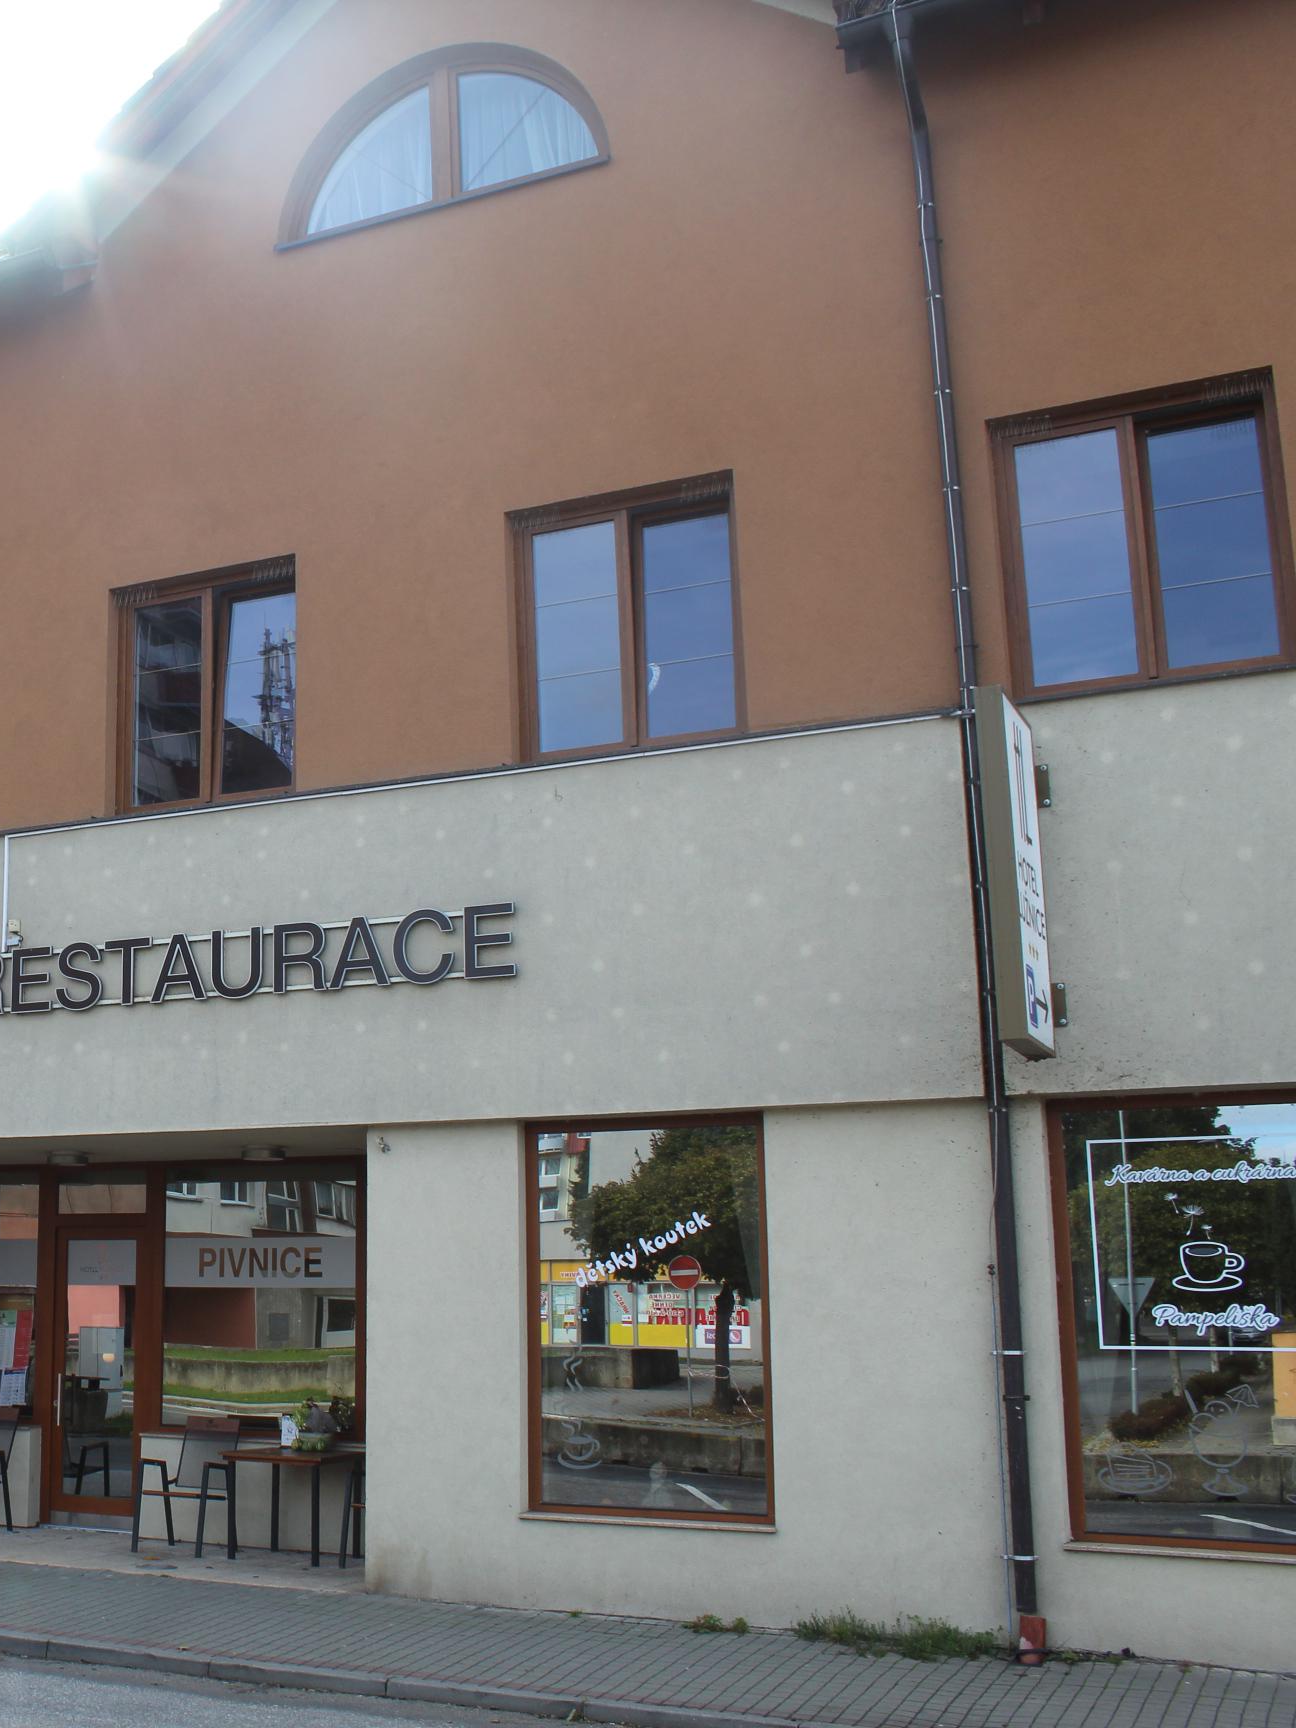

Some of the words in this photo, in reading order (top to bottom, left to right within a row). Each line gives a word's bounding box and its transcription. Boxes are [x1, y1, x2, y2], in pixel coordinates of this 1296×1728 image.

[1105, 1164, 1191, 1187] Kavárna
[1193, 1169, 1210, 1182] a
[638, 1211, 711, 1256] koutek
[198, 1246, 323, 1279] PIVNICE
[1152, 1303, 1280, 1336] Pampeliška
